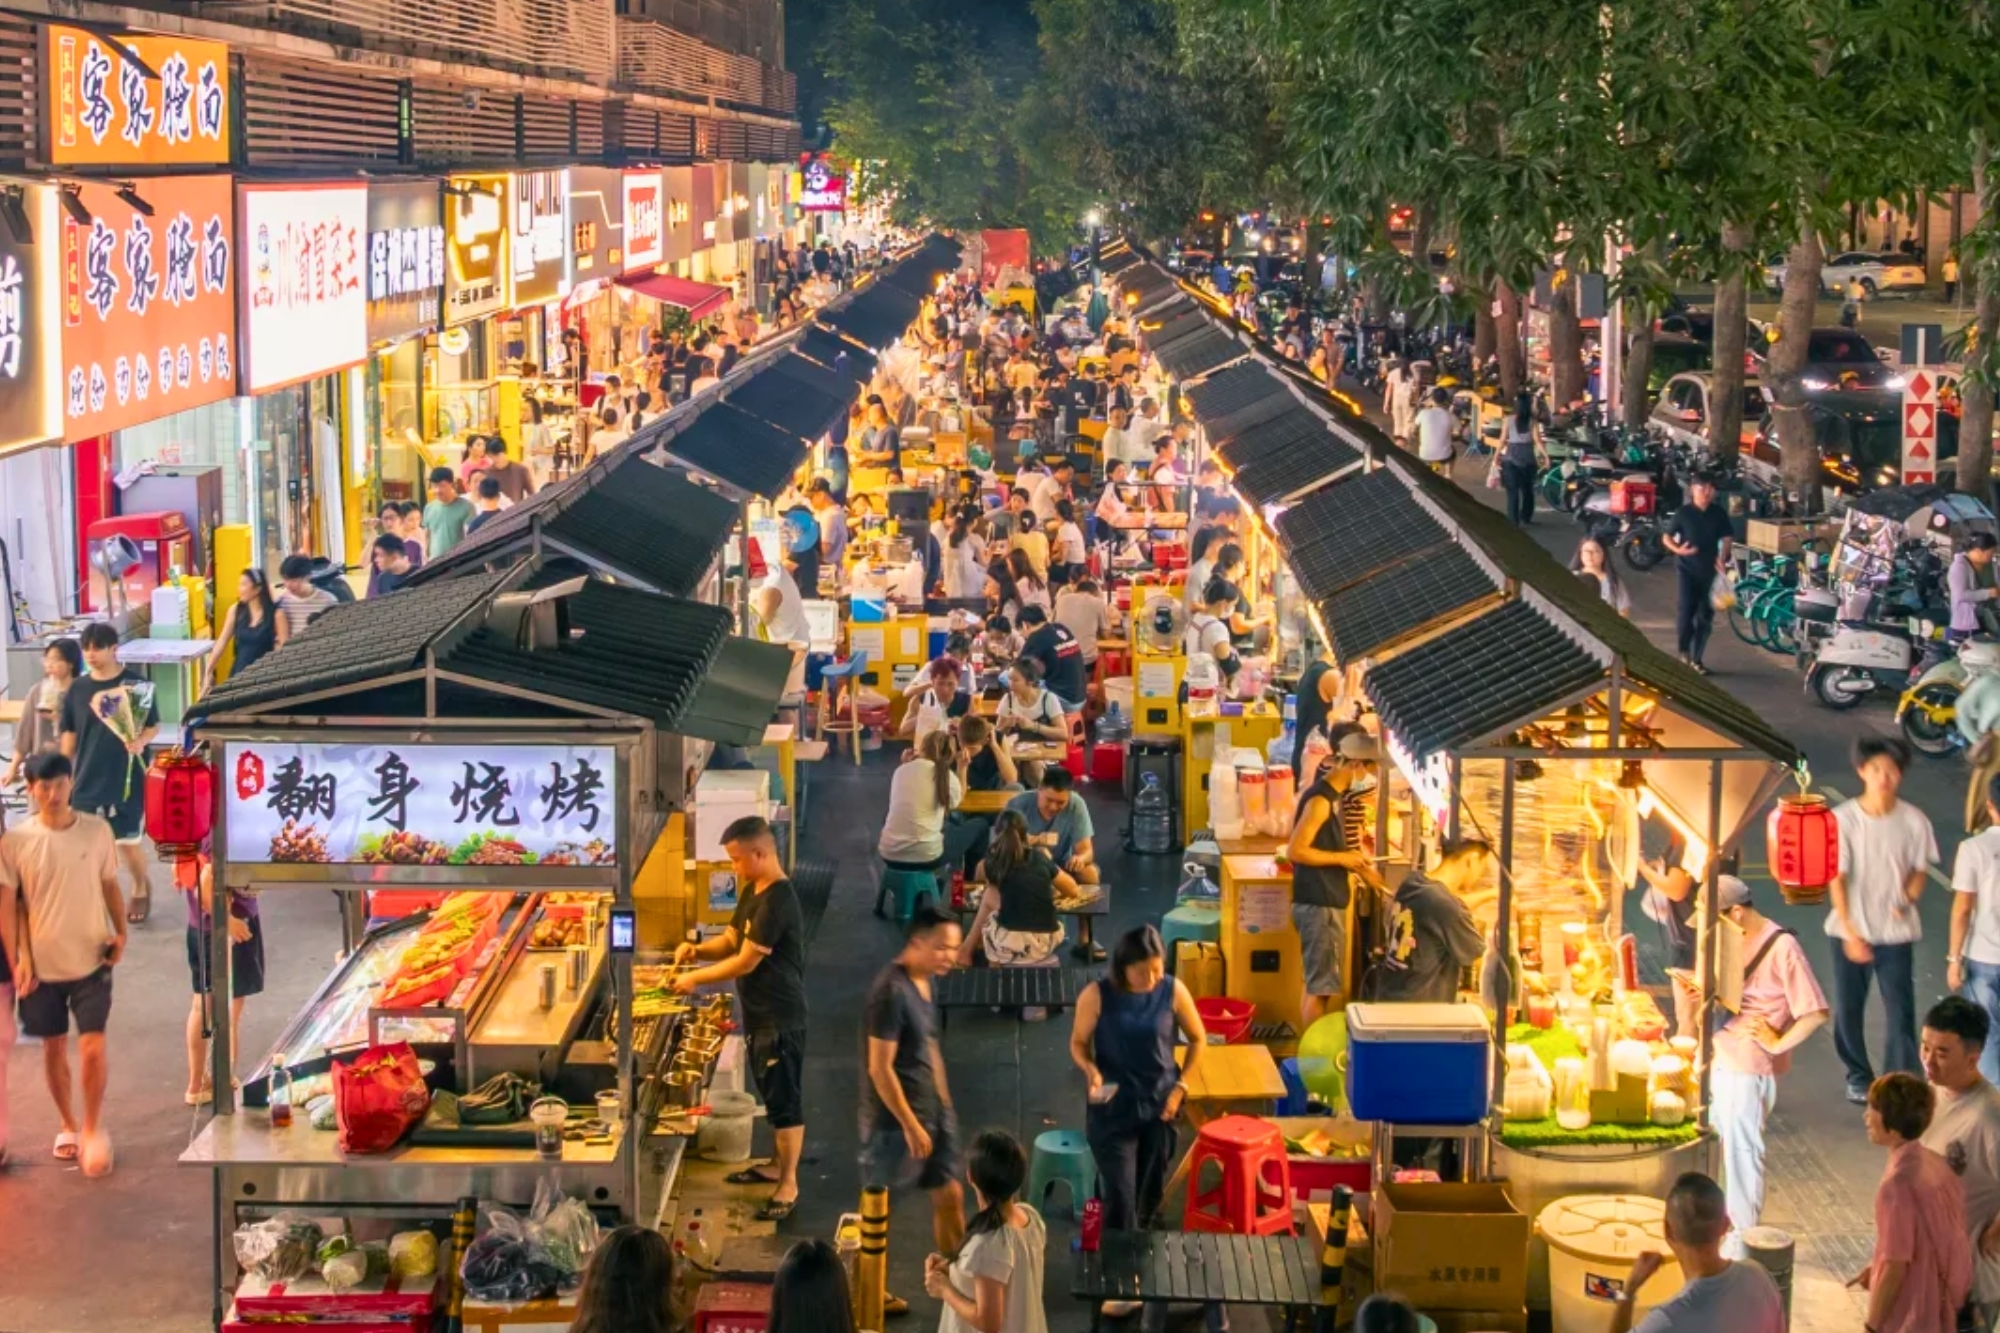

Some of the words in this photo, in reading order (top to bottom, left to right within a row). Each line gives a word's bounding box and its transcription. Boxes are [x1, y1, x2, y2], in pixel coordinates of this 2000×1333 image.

[86, 212, 230, 321] 客家腌面
[267, 752, 604, 832] 翻身烧烤
[1086, 1202, 1100, 1213] 02
[1428, 1265, 1501, 1283] 水果专用箱
